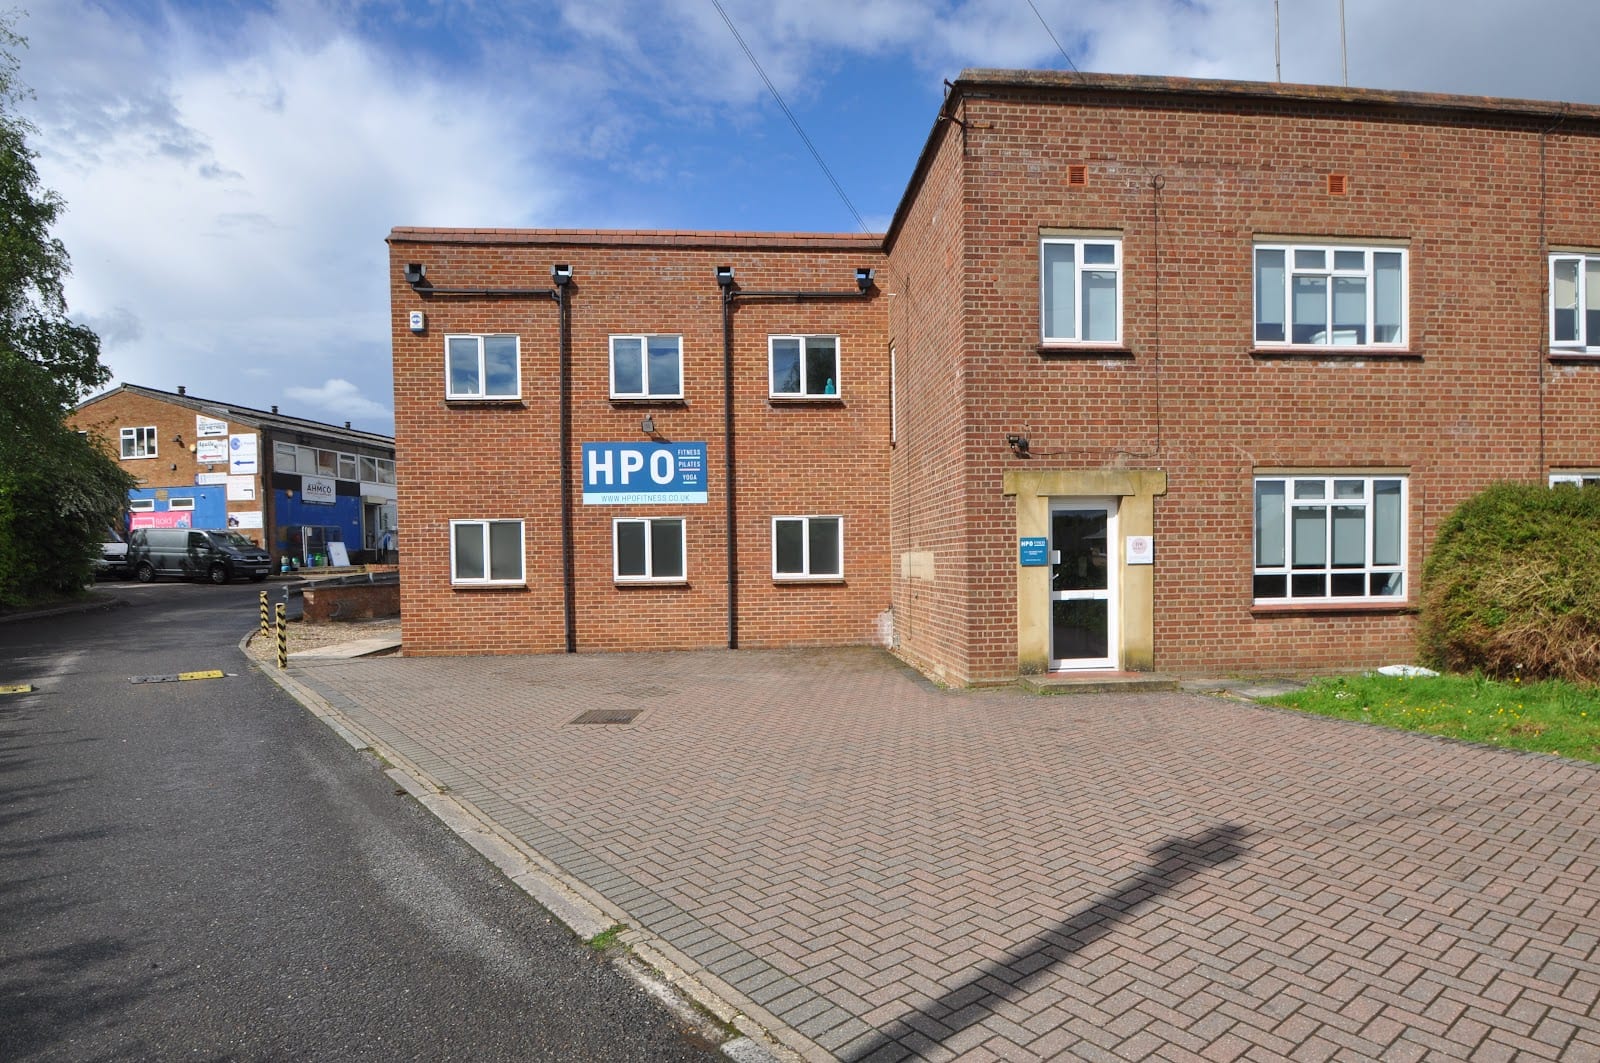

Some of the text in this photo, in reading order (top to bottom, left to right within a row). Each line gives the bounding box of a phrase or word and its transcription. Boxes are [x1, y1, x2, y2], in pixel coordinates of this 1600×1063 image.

[677, 448, 701, 456] FITNESS
[588, 449, 675, 485] HPO
[678, 460, 701, 468] PILATES
[682, 473, 697, 481] YOGA
[306, 483, 332, 494] AHMCO
[601, 494, 690, 503] WWW.HPOFITNESS.CO.UK
